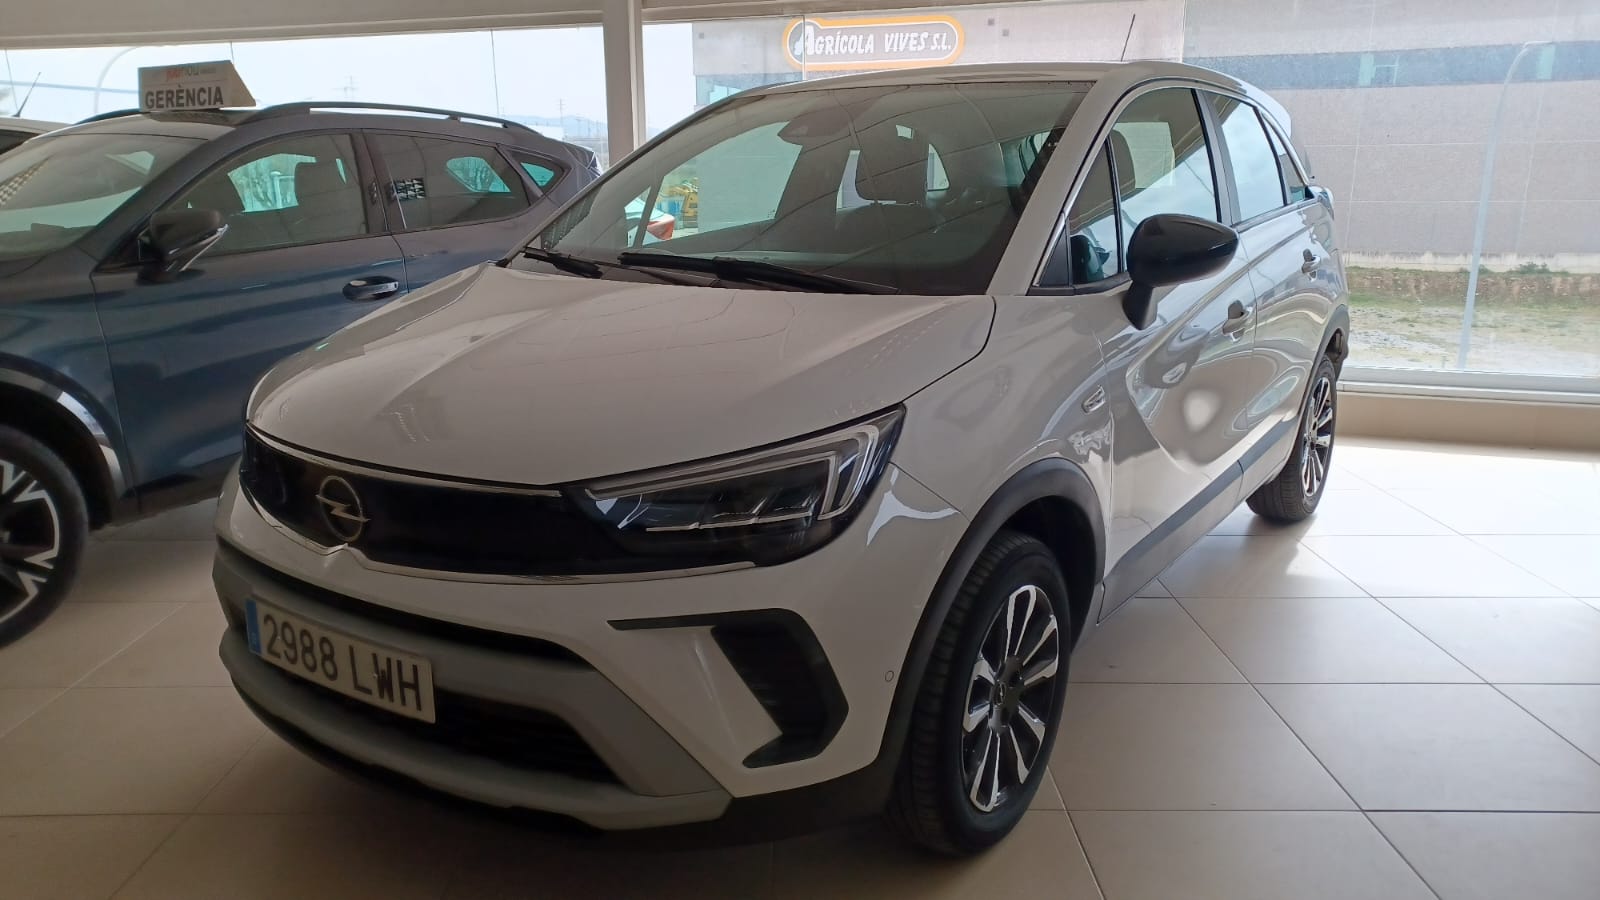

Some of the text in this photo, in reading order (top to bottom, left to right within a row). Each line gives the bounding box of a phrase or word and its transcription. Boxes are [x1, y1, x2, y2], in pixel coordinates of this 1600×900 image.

[794, 25, 951, 56] AGRÍCOLA VIVES S.L.
[145, 84, 224, 109] GERÈNCIA
[263, 614, 422, 711] 2988 LWH
